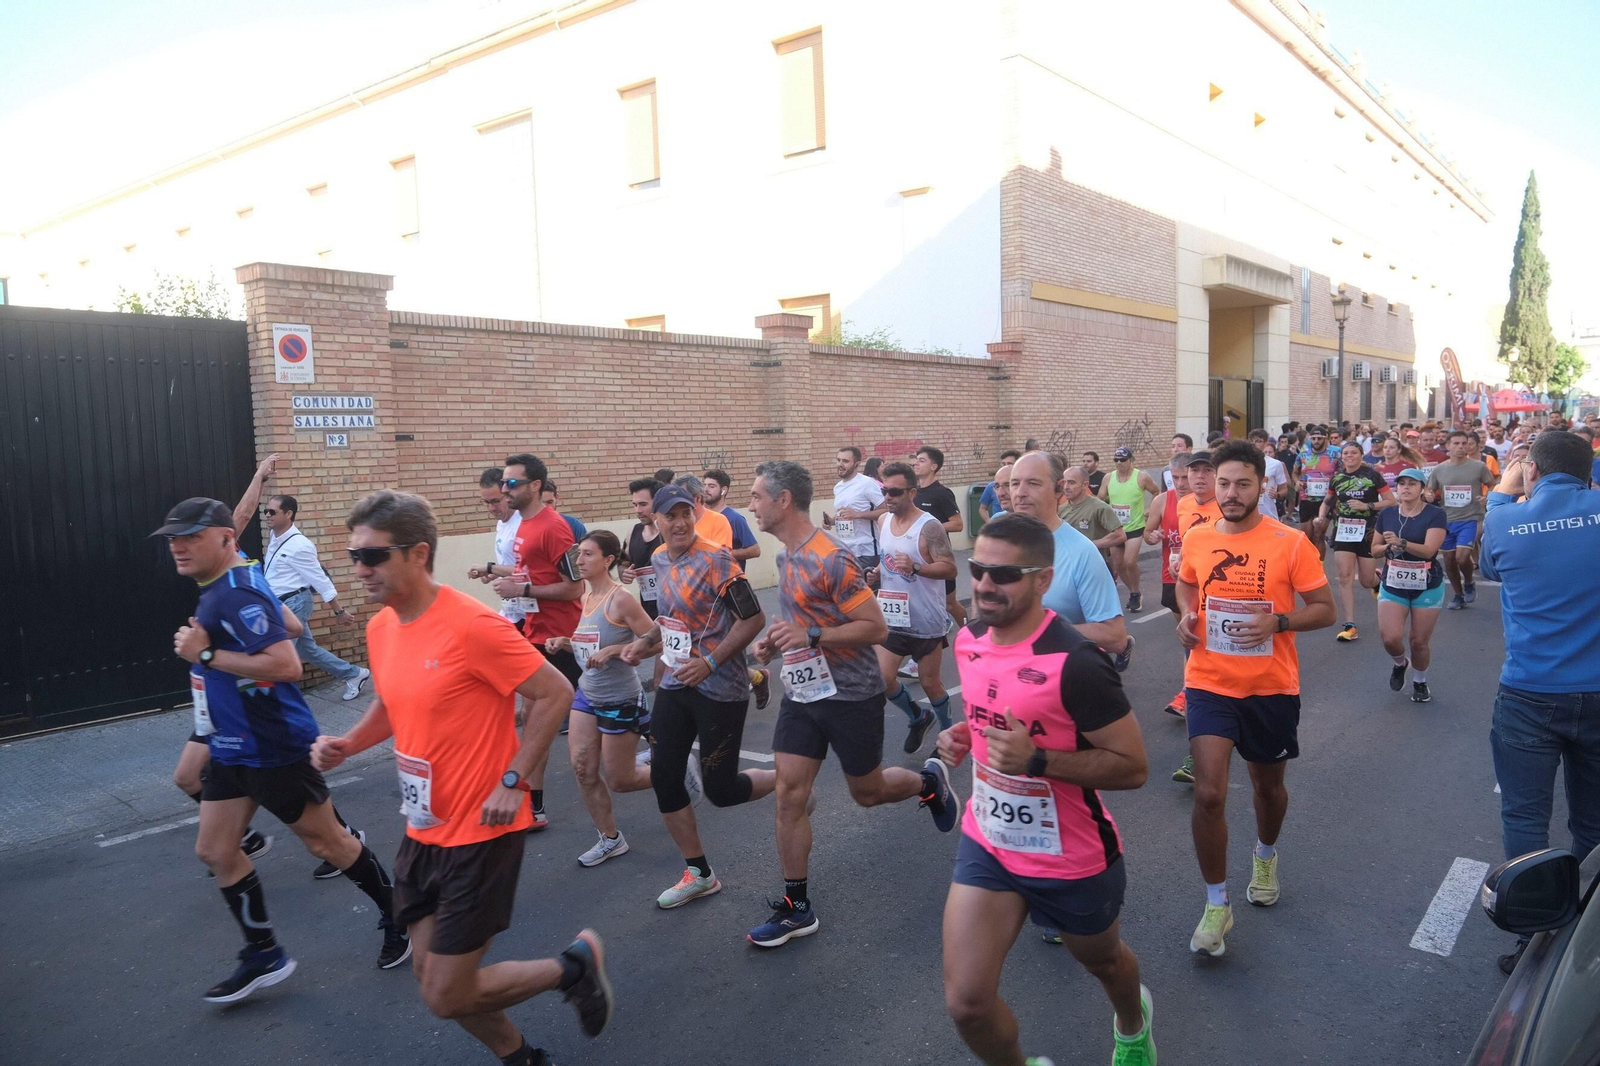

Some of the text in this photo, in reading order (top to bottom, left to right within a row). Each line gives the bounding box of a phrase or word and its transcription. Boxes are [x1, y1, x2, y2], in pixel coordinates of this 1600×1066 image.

[293, 397, 372, 408] COMUNIDAD
[295, 416, 373, 427] SALESIANA
[838, 523, 849, 531] 124
[1344, 527, 1358, 535] 187
[1257, 559, 1267, 595] 24.09.22
[1396, 571, 1417, 581] 678
[883, 602, 901, 613] 213
[580, 647, 590, 659] 70
[788, 667, 817, 685] 282
[989, 796, 1034, 825] 296
